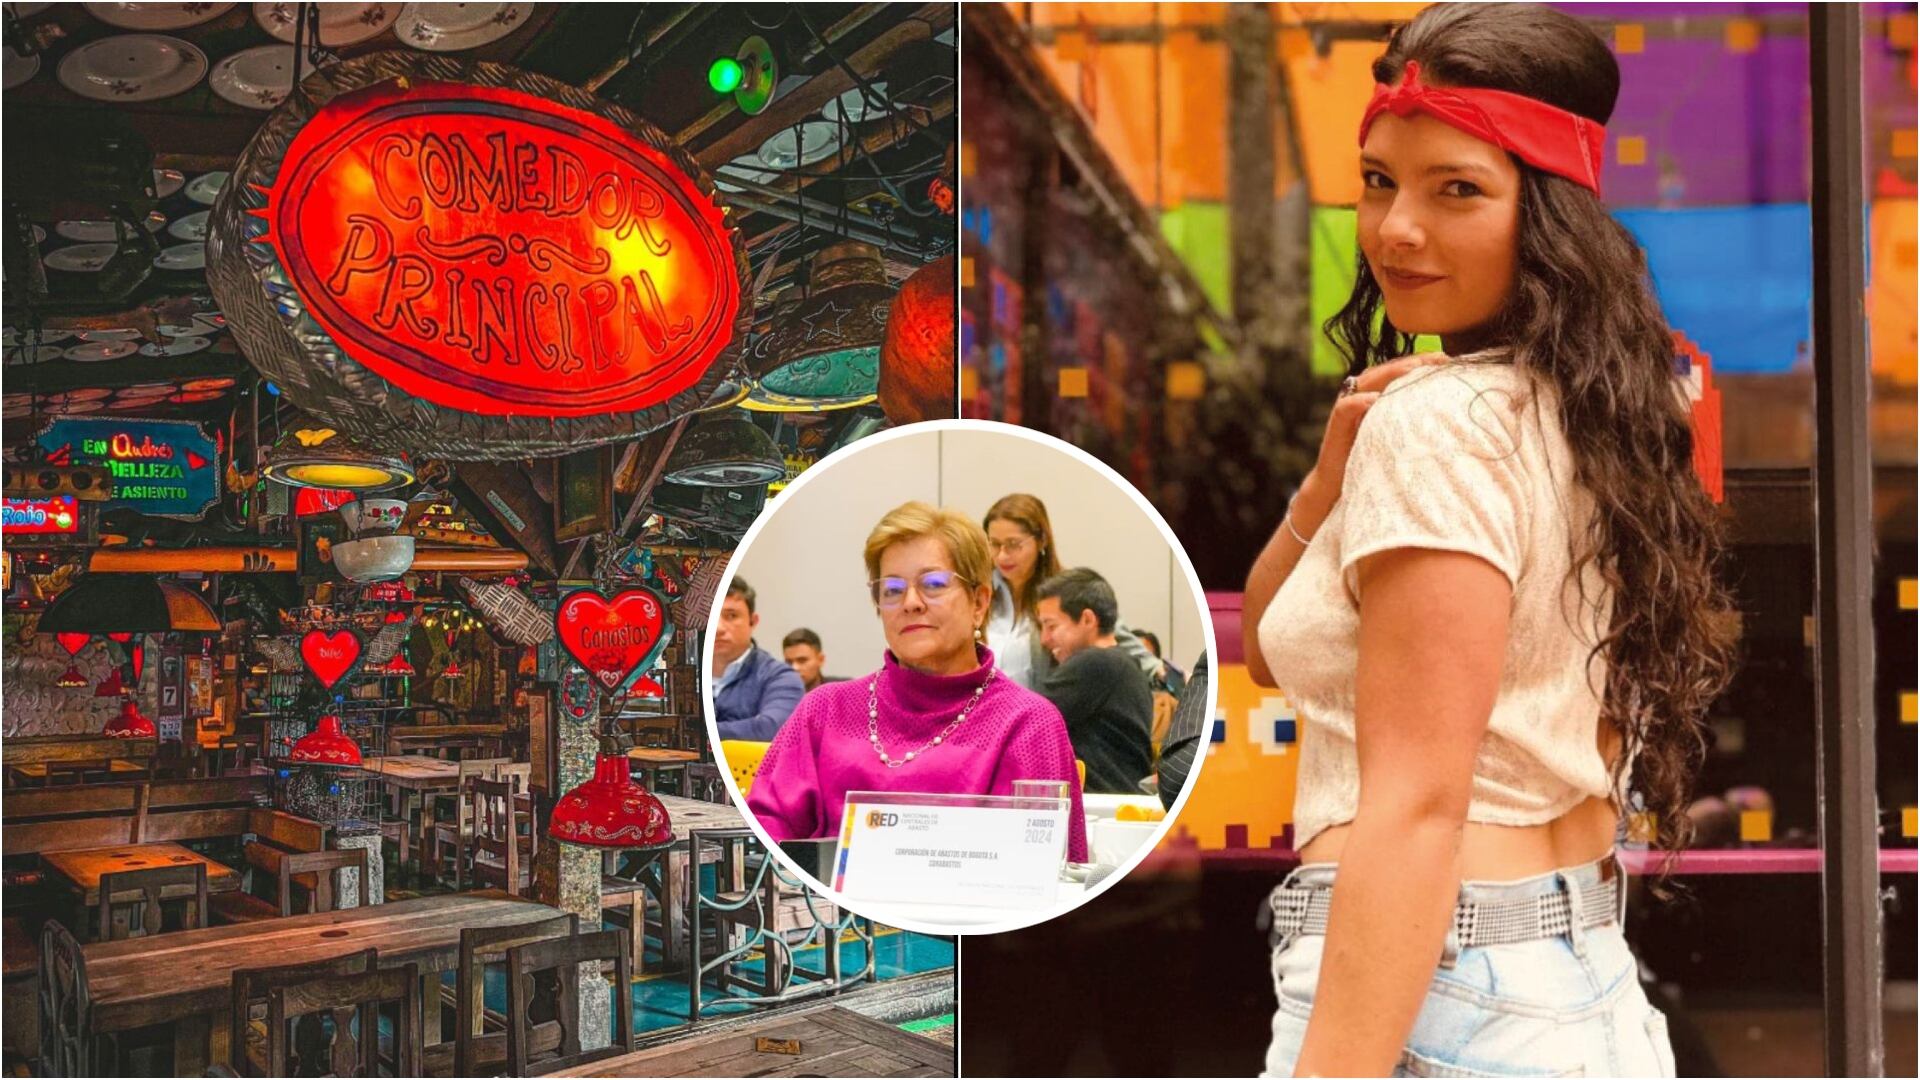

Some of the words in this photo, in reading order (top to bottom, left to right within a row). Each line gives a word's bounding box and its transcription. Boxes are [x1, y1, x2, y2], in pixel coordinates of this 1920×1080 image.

[370, 132, 672, 256] COMEDOR
[327, 215, 694, 375] PRINCIPAL
[83, 439, 107, 455] EN
[121, 486, 187, 499] ASIENTO
[165, 688, 176, 704] 7
[869, 812, 898, 827] RED
[1032, 819, 1055, 828] AGOSTO
[1024, 829, 1053, 844] 2024
[930, 849, 937, 857] DE
[961, 850, 968, 858] DE
